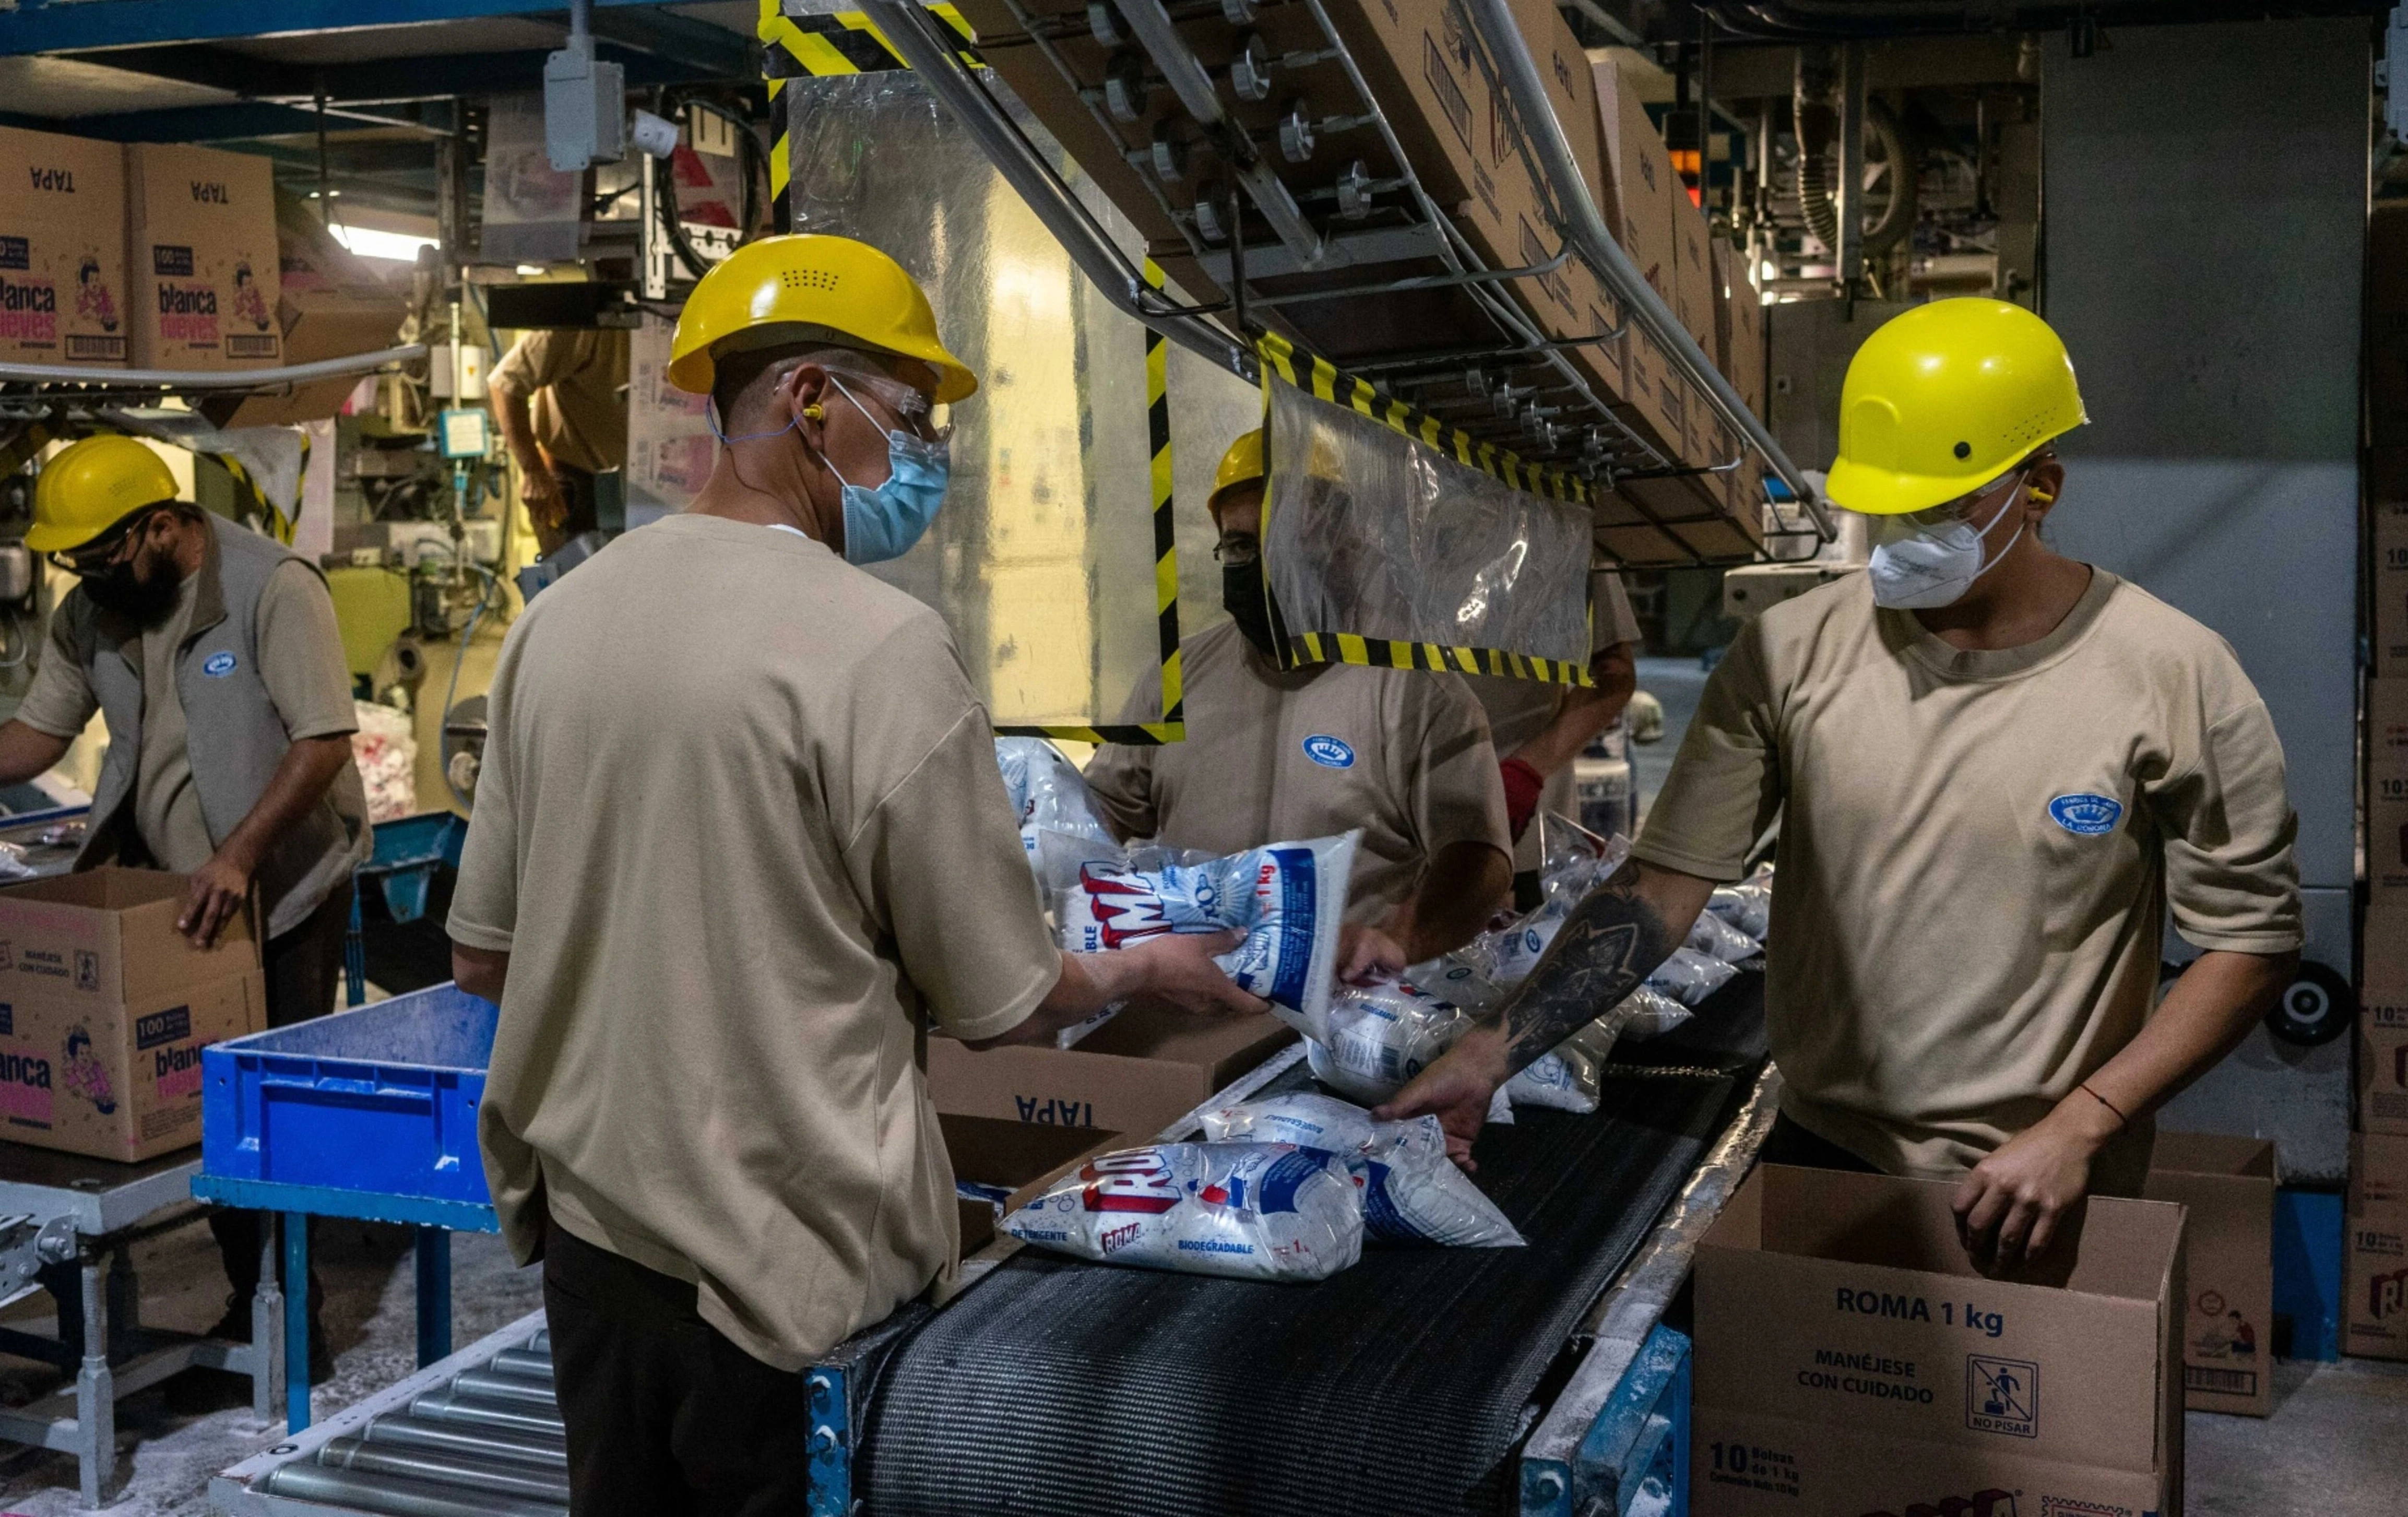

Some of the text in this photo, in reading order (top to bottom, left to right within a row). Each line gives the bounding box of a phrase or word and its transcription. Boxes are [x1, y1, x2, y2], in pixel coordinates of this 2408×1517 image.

[30, 168, 75, 192] TAPA
[191, 181, 229, 204] TAPA
[0, 277, 55, 313] lanca
[158, 282, 216, 315] blanca
[2061, 818, 2072, 829] LA
[1256, 864, 1276, 885] kg
[2375, 1006, 2395, 1022] 10
[139, 1017, 164, 1038] 100
[1015, 1095, 1093, 1128] TAPA
[1011, 1228, 1068, 1242] DETERGENTE
[1101, 1222, 1142, 1255] ROMA
[2356, 1231, 2376, 1247] 10
[1178, 1240, 1254, 1254] BIODEGRADABLE
[1836, 1287, 2003, 1337] ROMA 1 kg
[1814, 1349, 1916, 1378] MANÉJESE
[1797, 1370, 1933, 1404] CON CUIDADO
[1973, 1417, 2031, 1435] NO PISAR
[1710, 1441, 1747, 1473] 10
[1752, 1445, 1794, 1464] Bolsas
[1752, 1463, 1766, 1475] de
[1784, 1467, 1799, 1484] kg
